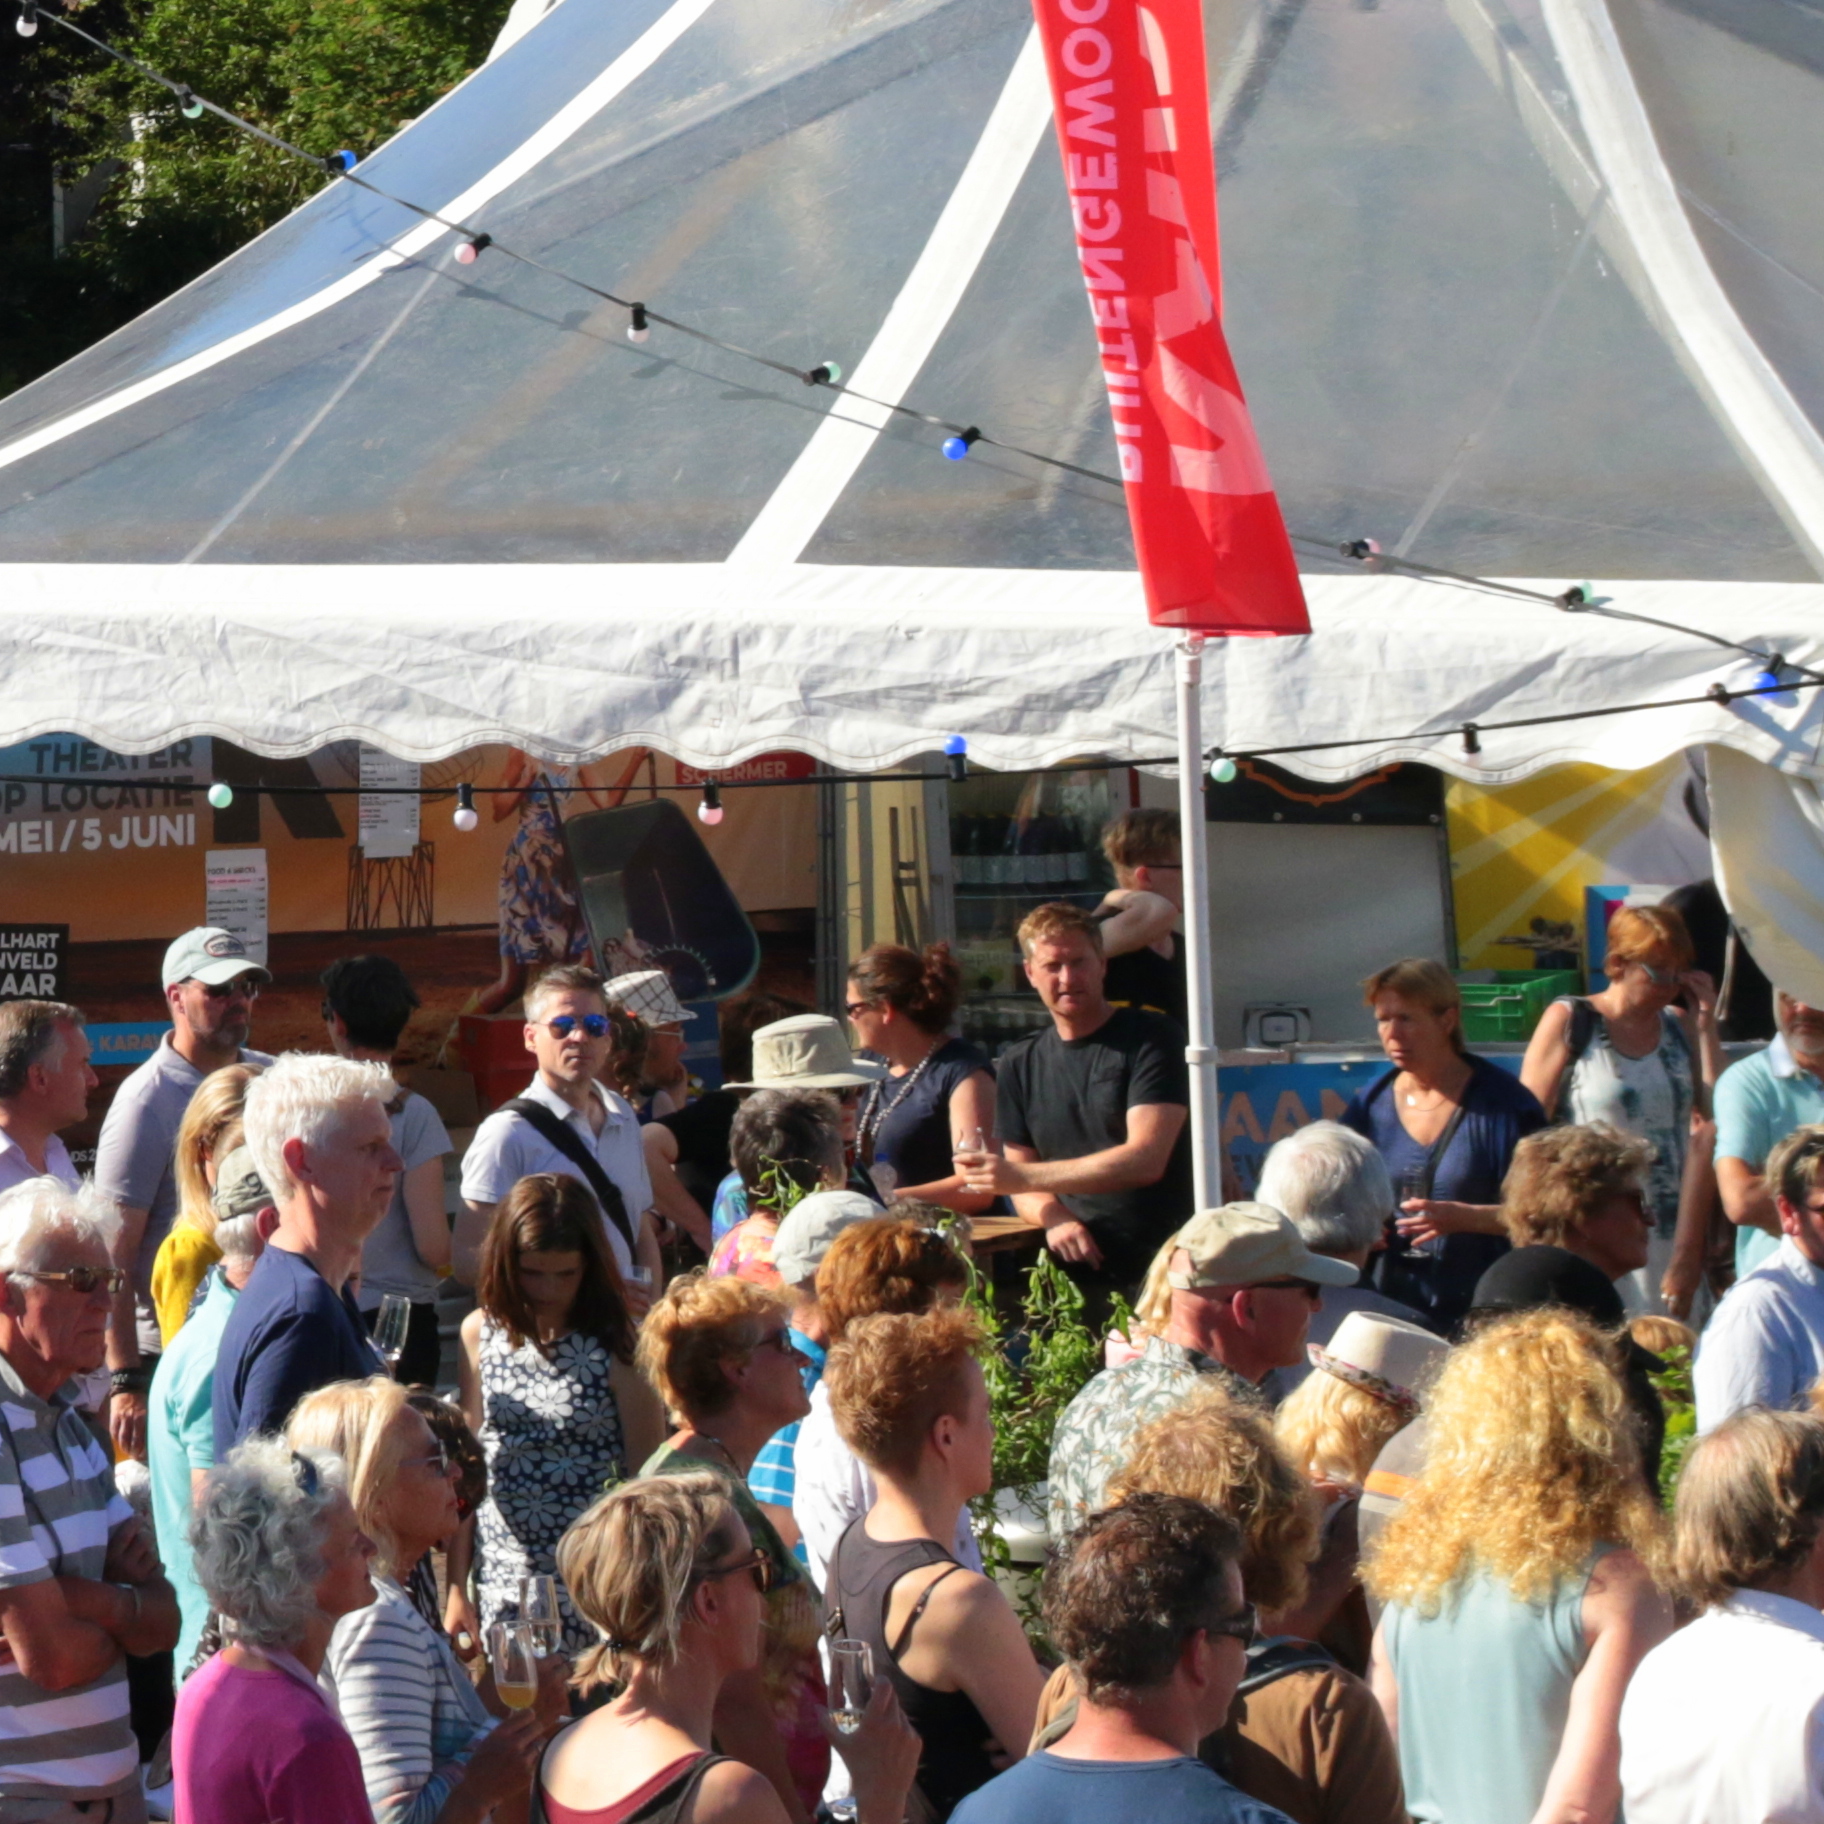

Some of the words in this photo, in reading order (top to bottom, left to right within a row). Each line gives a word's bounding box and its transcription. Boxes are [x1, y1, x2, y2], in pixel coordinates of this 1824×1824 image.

[41, 775, 195, 813] LOCATIE
[81, 817, 103, 851] 5
[109, 813, 196, 850] JUNI
